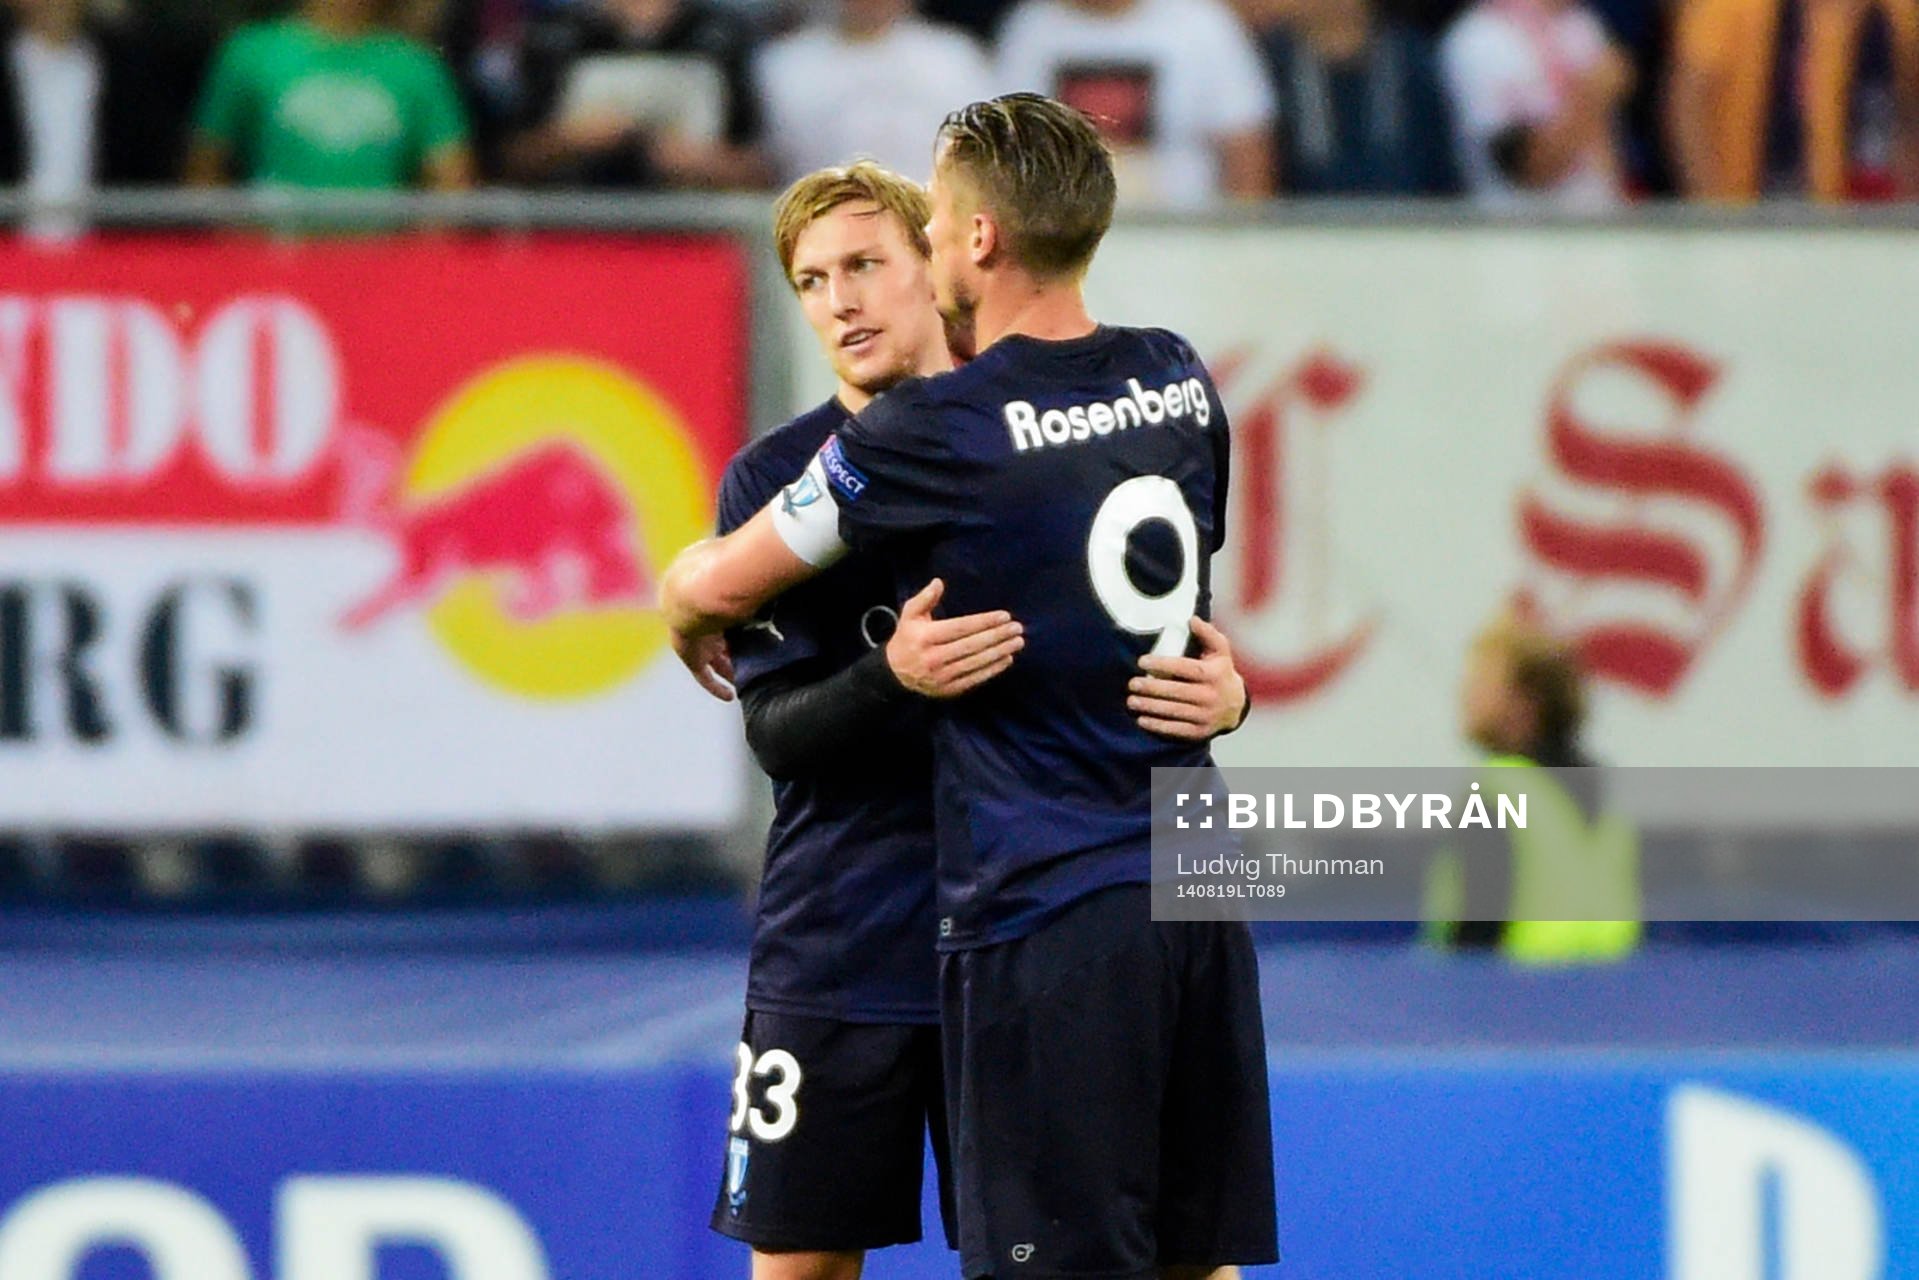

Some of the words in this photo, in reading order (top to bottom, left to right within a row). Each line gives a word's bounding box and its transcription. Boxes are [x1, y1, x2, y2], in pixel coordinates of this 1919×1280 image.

[0, 295, 338, 482] DO
[1004, 376, 1210, 452] Rosenberg
[1089, 475, 1199, 678] 9
